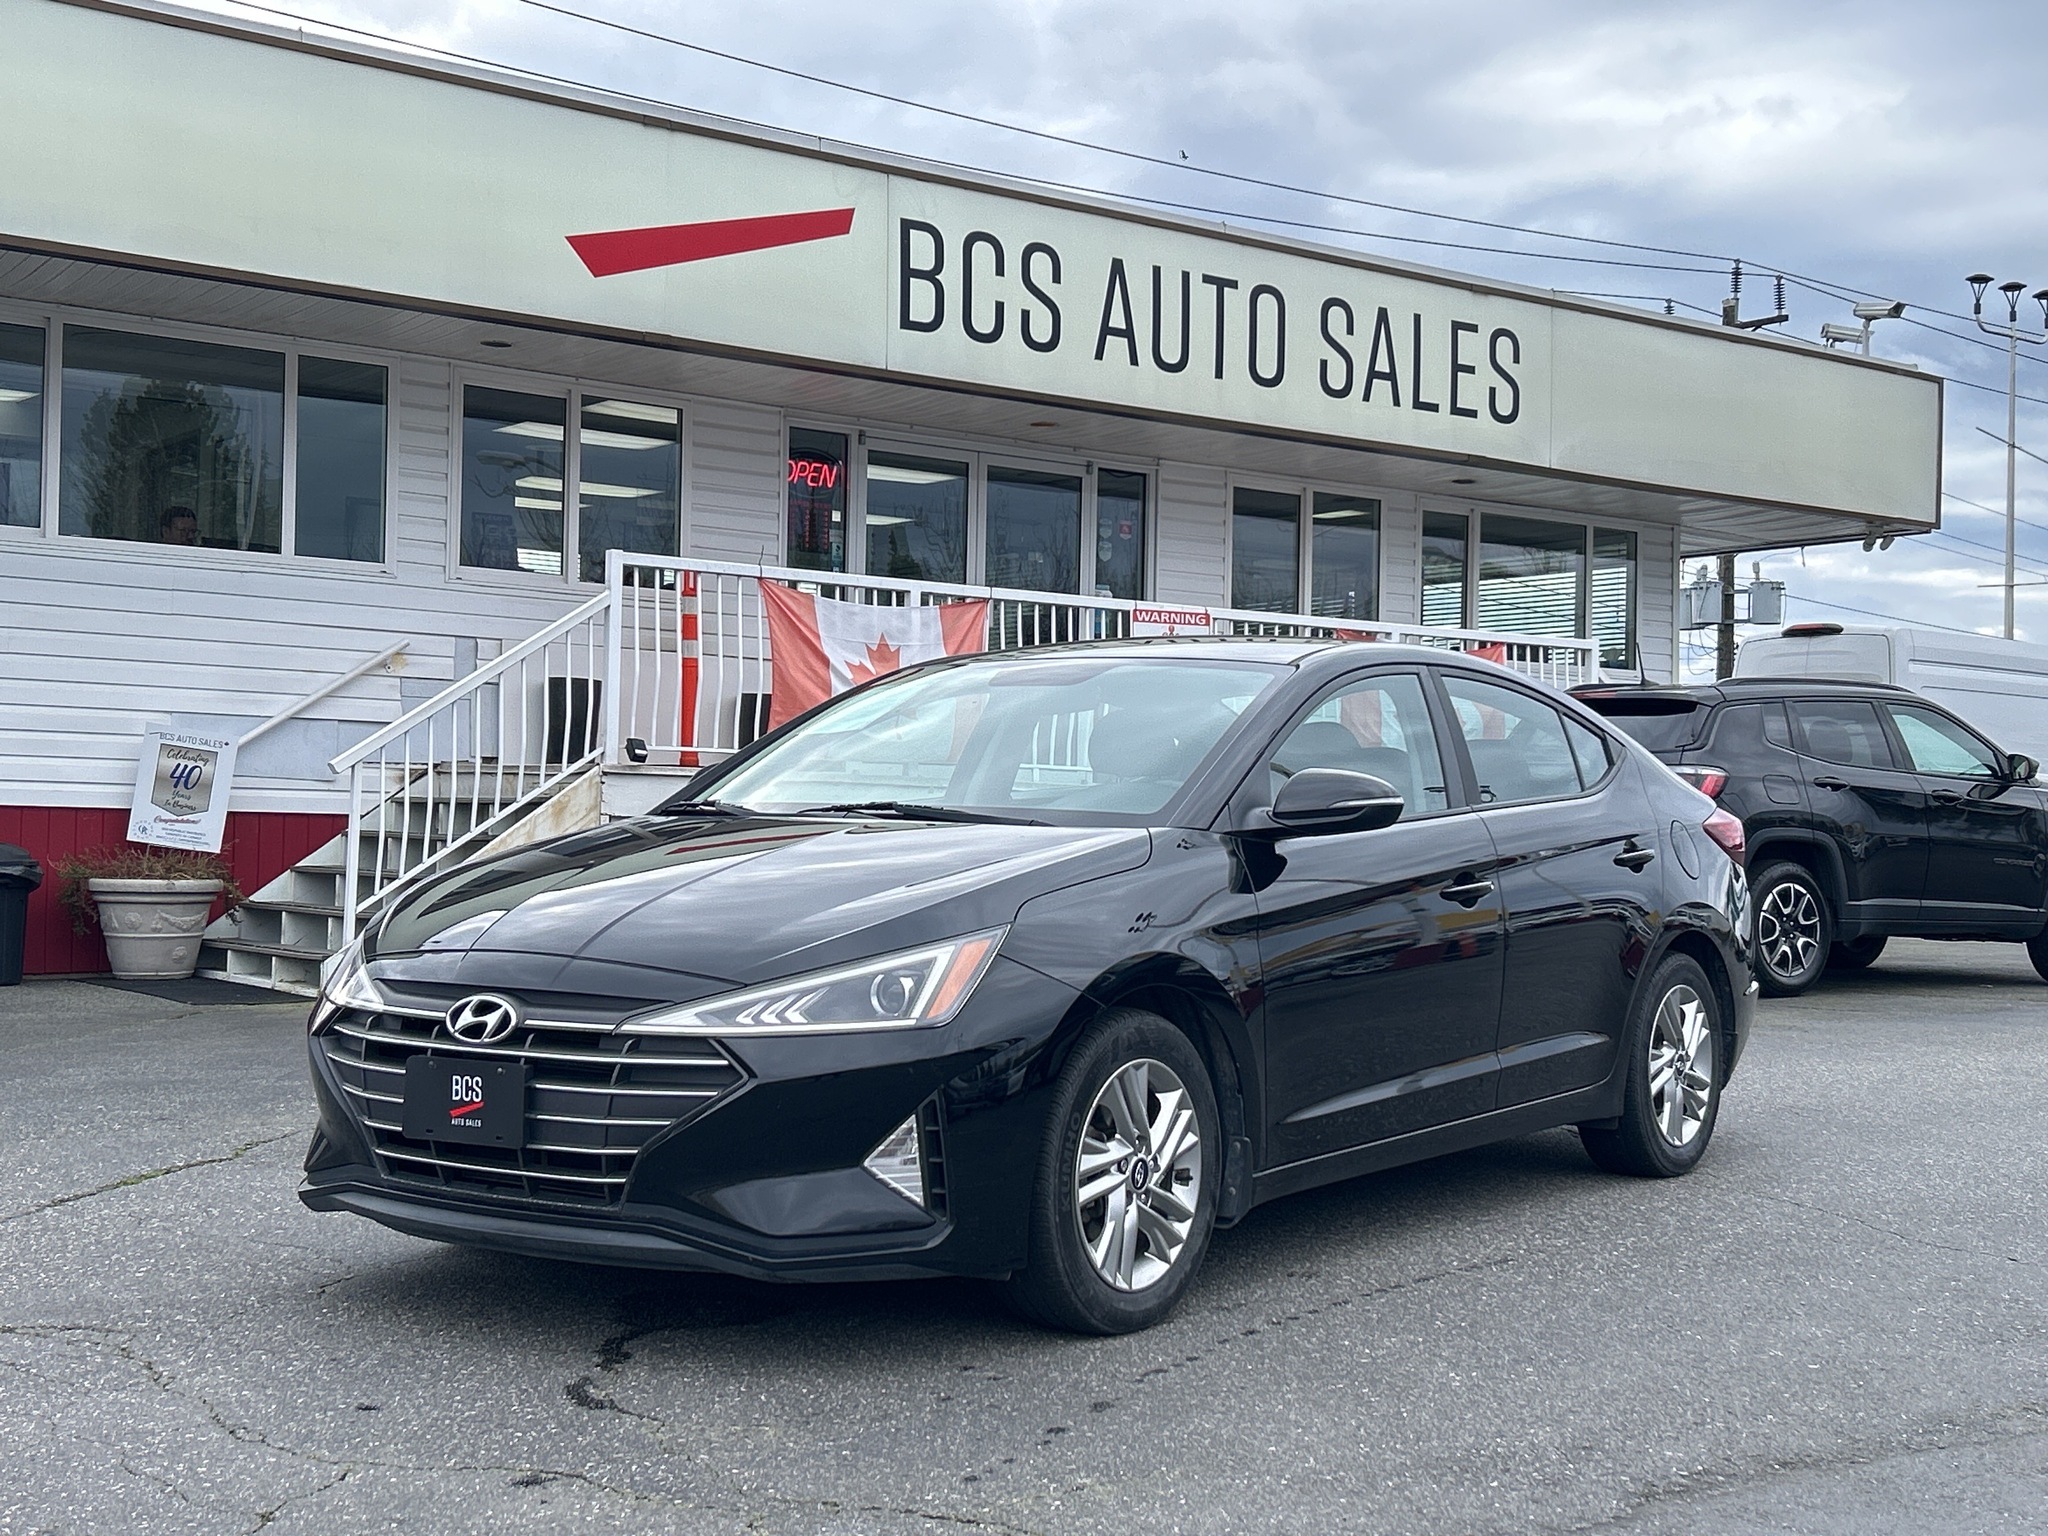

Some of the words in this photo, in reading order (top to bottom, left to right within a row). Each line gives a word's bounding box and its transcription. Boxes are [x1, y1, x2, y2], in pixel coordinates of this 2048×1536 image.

[900, 217, 1062, 353] BCS
[1094, 257, 1286, 388] AUTO
[1319, 297, 1520, 424] SALES
[1136, 610, 1207, 625] WARNING
[160, 732, 176, 742] BCS
[176, 734, 198, 745] AUTO
[198, 738, 223, 749] SALES
[166, 748, 210, 767] Celebrating
[169, 762, 203, 790] 40
[171, 790, 192, 800] Years
[452, 1075, 482, 1102] BCS
[1060, 1111, 1081, 1213] KUMHO
